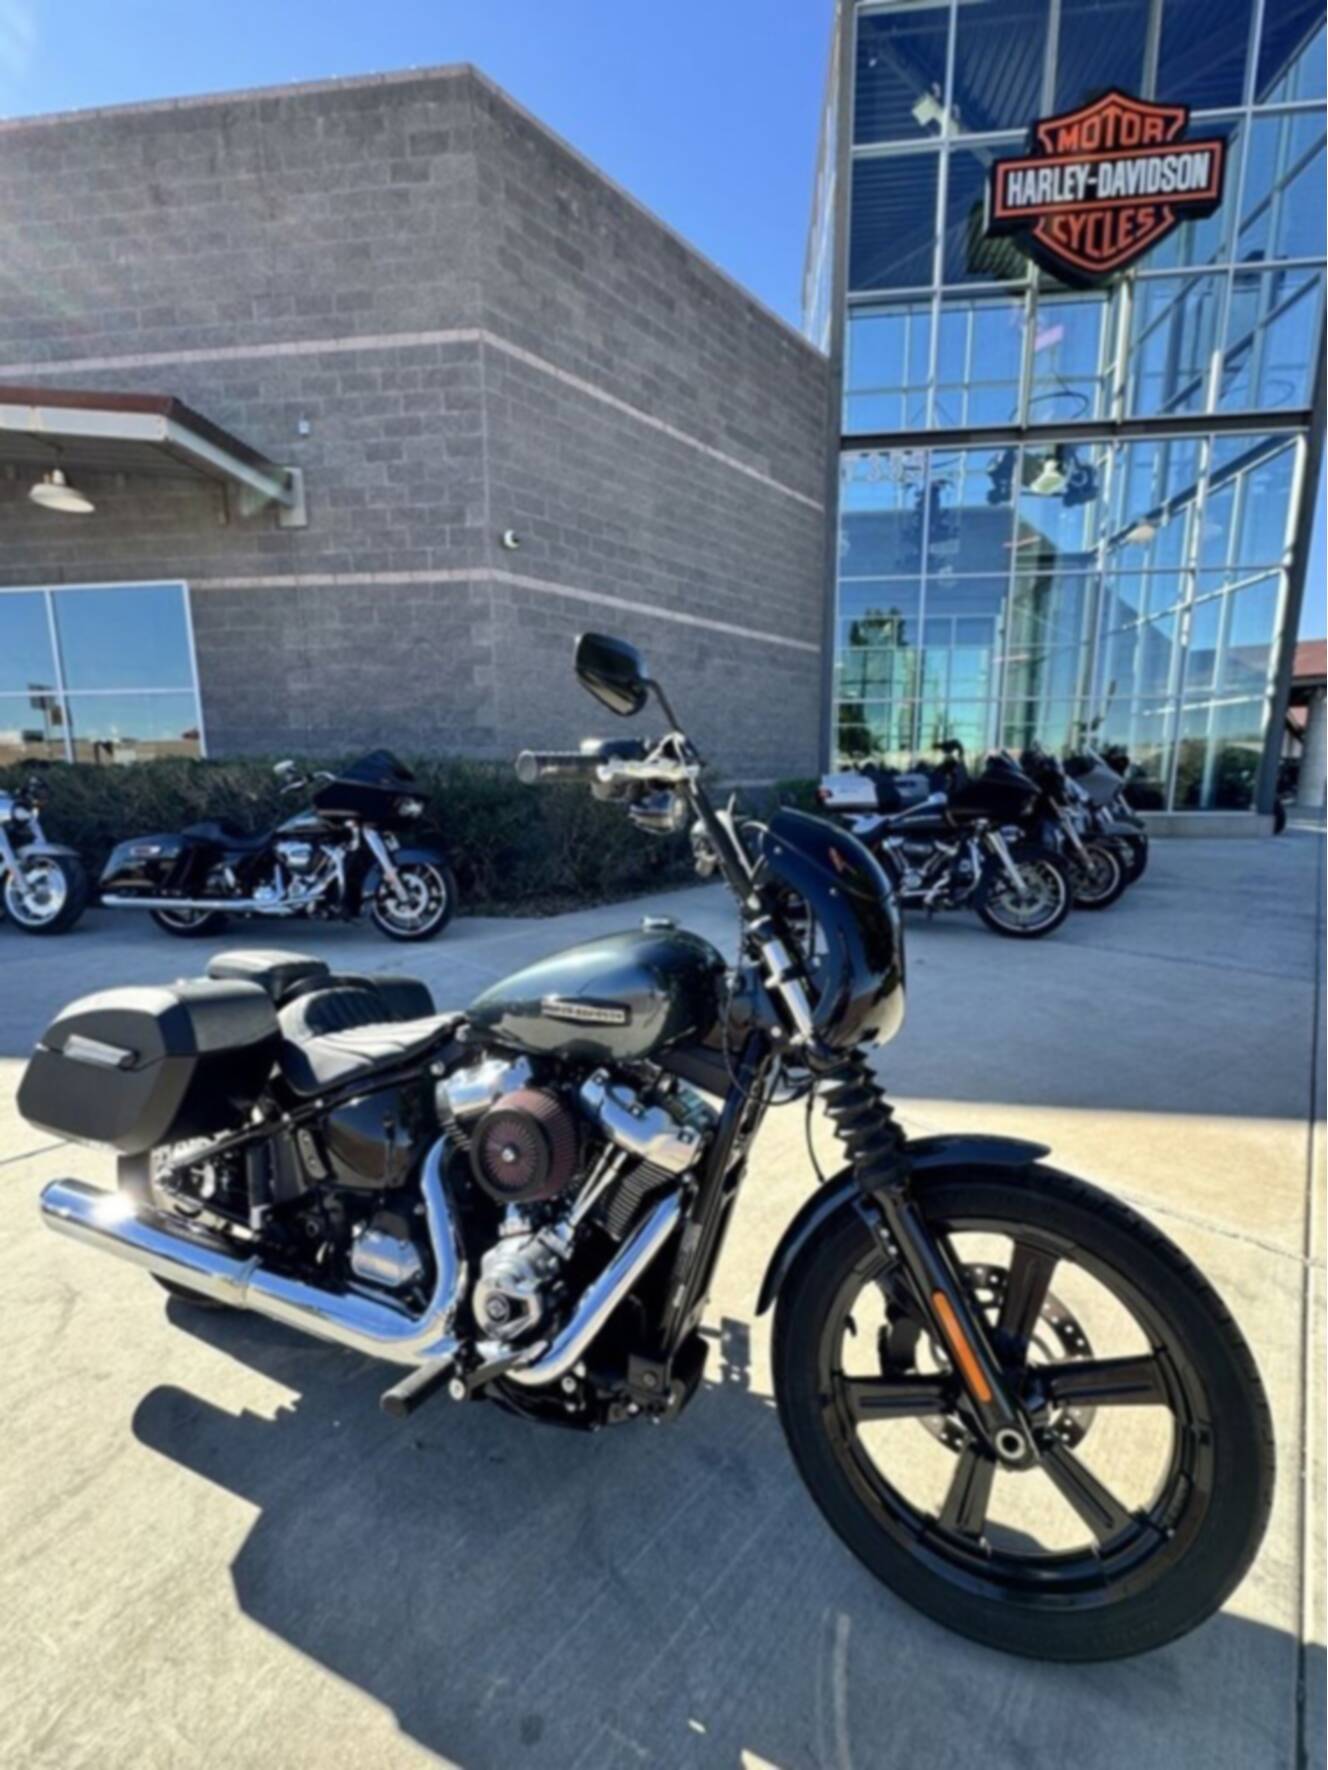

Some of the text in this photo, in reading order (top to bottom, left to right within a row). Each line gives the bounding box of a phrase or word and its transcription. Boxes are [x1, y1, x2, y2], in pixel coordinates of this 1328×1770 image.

[1057, 106, 1163, 151] MOTOR
[1006, 152, 1210, 207] HARLEY-DAVIDSON
[1051, 207, 1155, 257] CYCLES
